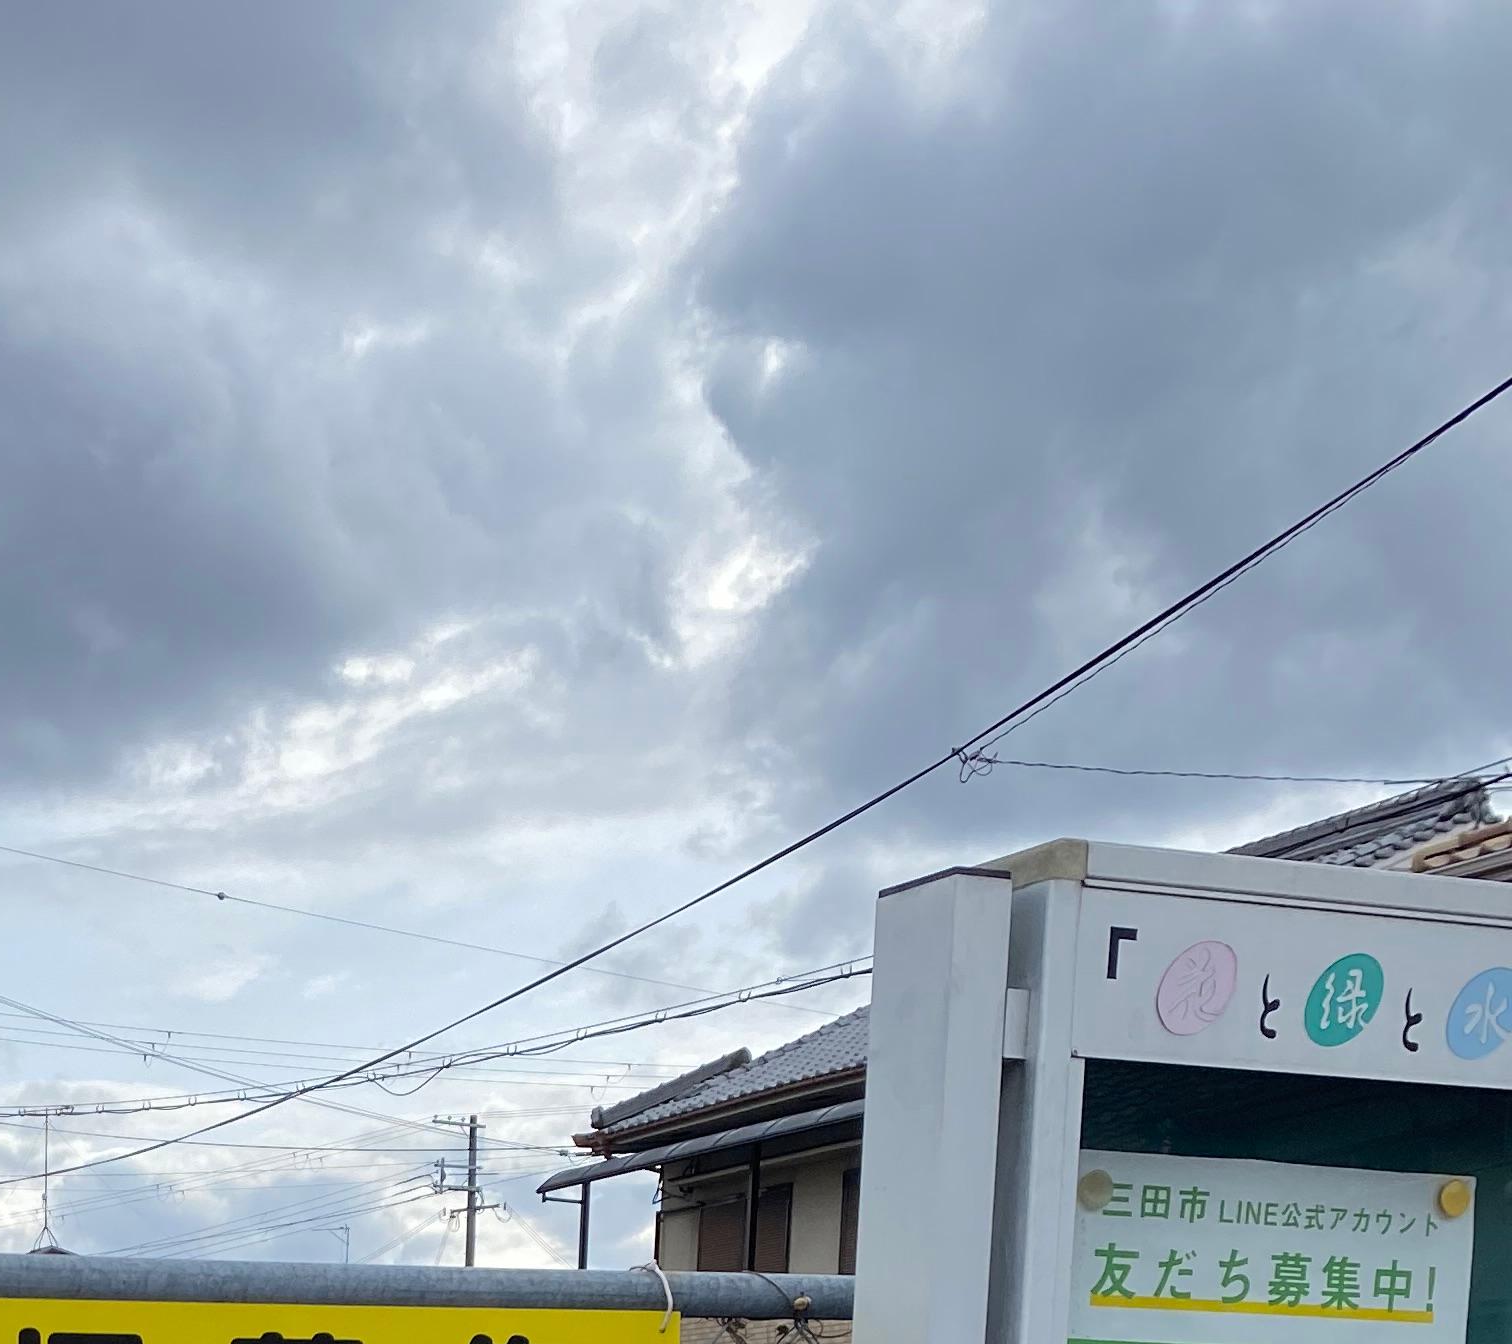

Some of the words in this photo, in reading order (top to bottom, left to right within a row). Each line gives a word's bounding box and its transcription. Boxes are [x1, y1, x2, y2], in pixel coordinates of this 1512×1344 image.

[1102, 1183, 1210, 1223] 三田市
[1219, 1199, 1439, 1238] LINE公式アカウント
